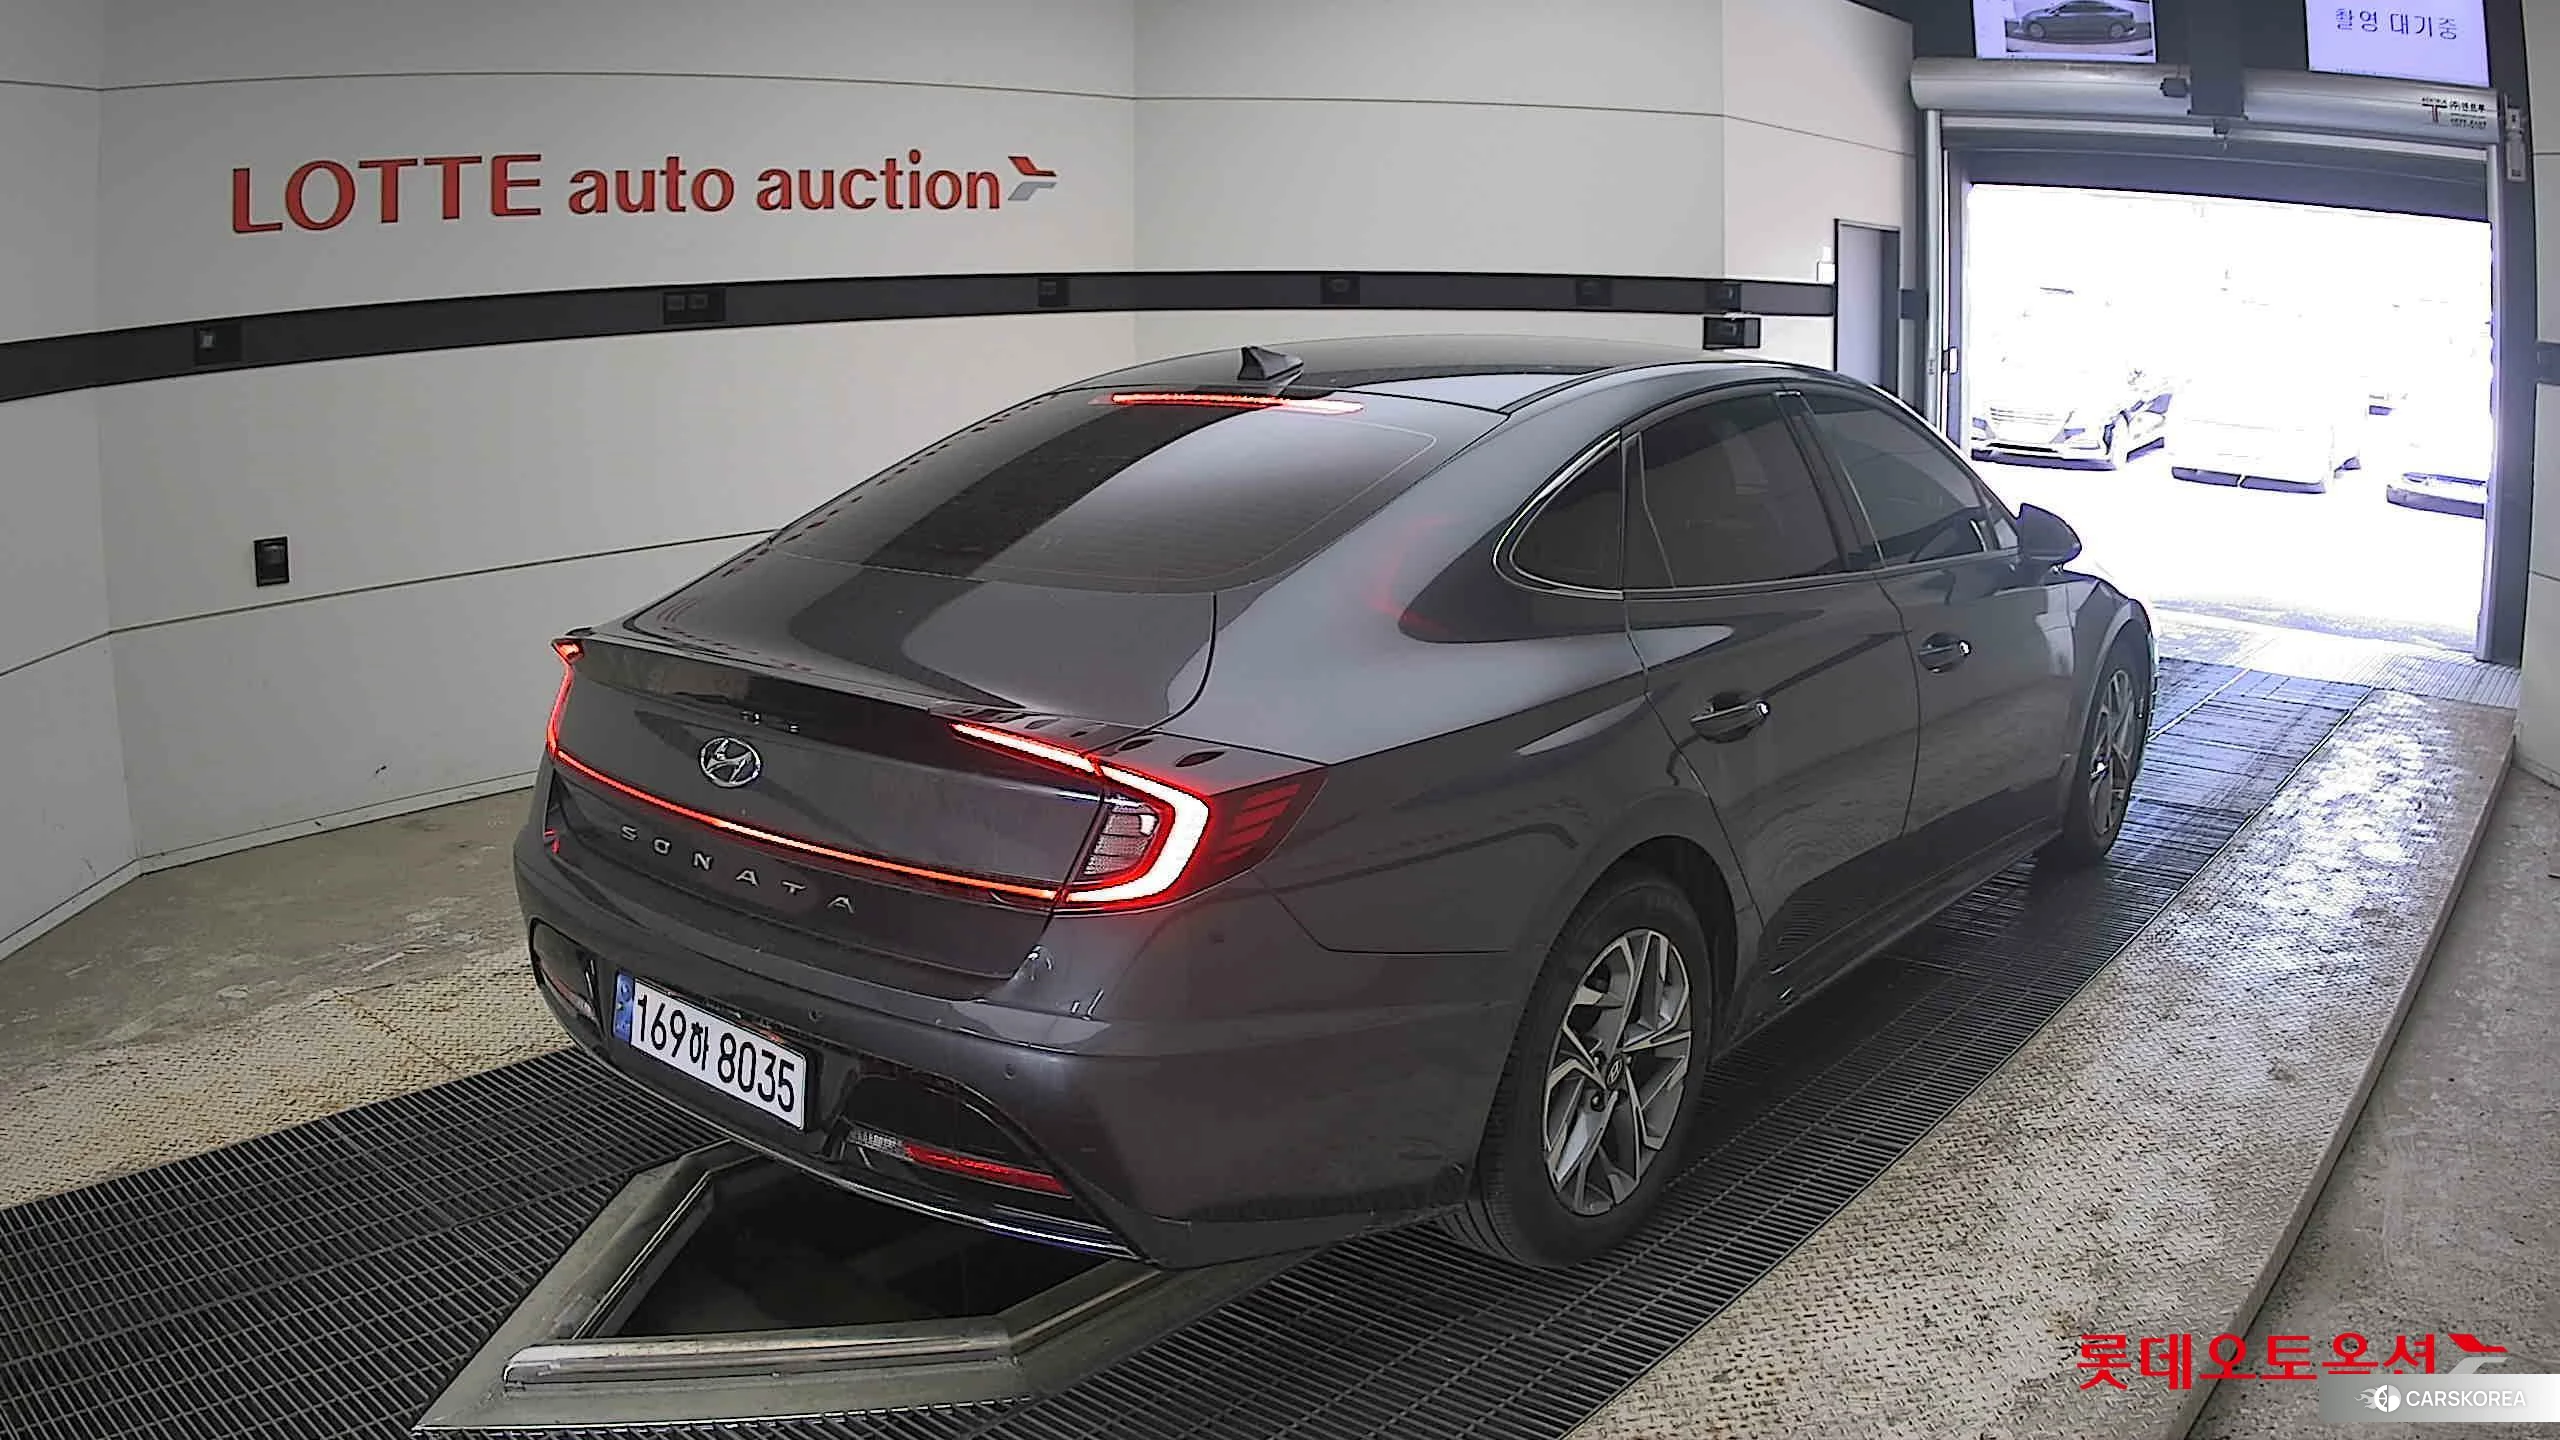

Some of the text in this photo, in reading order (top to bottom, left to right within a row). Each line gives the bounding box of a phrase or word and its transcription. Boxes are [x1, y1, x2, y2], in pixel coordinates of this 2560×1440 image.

[2335, 8, 2459, 41] 촬영 대기중
[232, 149, 1001, 234] LOTTE auto auction
[620, 823, 857, 915] SONATA
[637, 993, 796, 1113] 169하 8035
